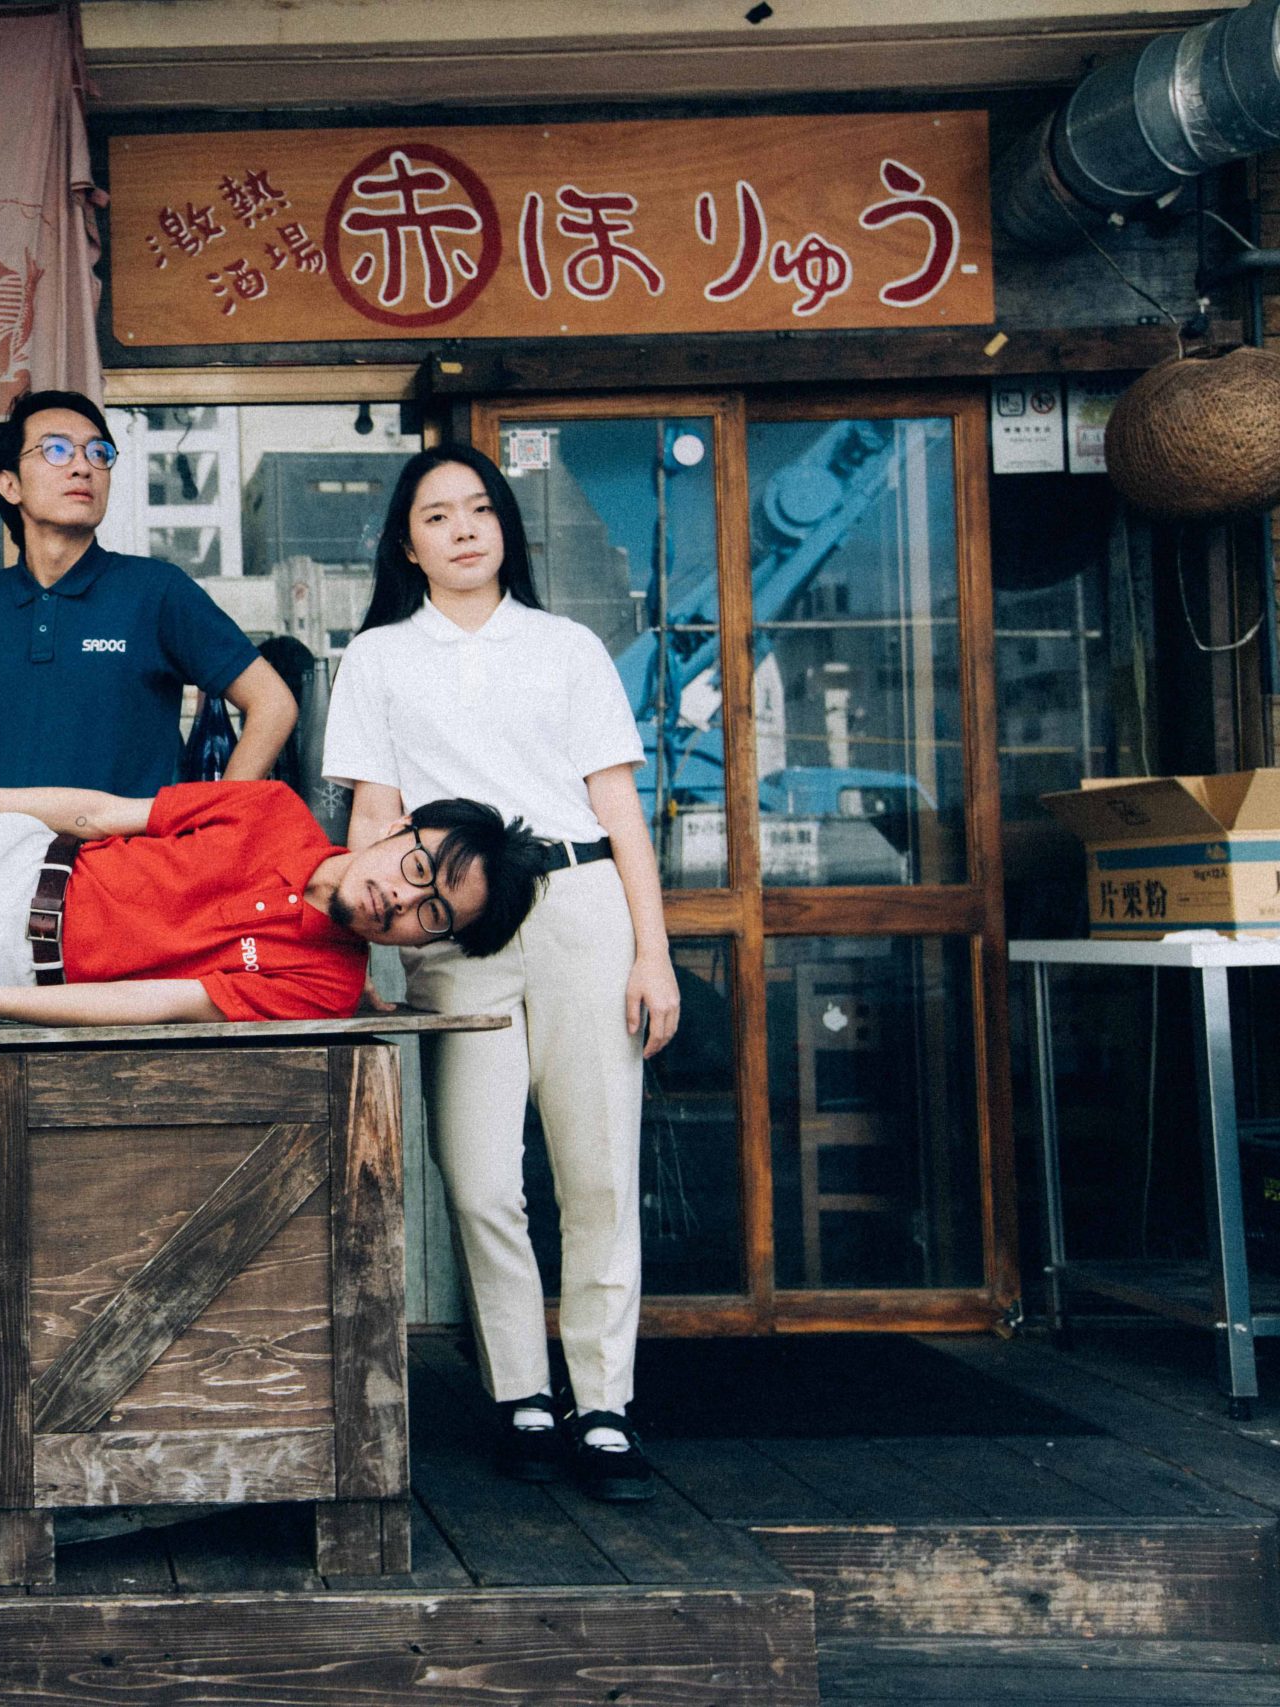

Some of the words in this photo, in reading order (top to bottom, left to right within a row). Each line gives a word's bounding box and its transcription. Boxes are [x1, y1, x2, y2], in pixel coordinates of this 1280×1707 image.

[206, 222, 327, 316] 酒場
[81, 638, 127, 653] SADOG
[1099, 878, 1167, 919] 片栗粉
[240, 936, 260, 972] SADO
